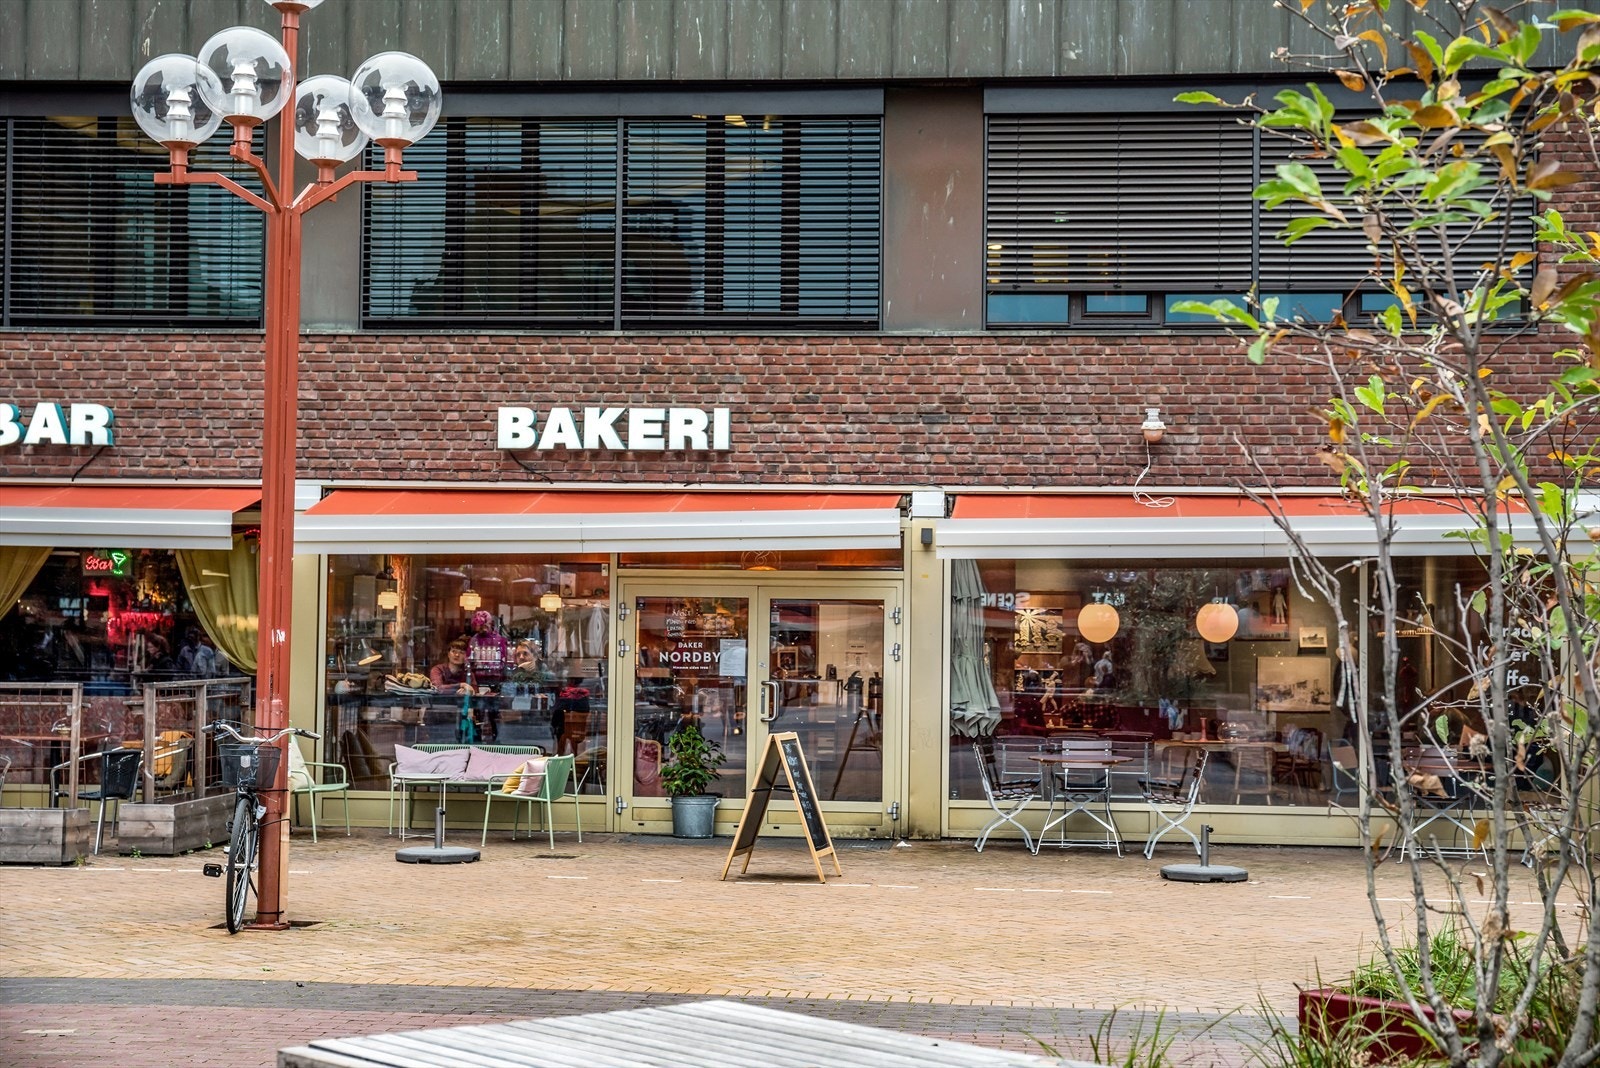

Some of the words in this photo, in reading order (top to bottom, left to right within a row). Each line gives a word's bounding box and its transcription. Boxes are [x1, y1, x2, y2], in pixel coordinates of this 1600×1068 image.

[0, 402, 113, 446] BAR
[497, 406, 731, 450] BAKERI
[85, 556, 113, 570] Bar
[659, 651, 721, 663] NORDBY
[1477, 645, 1530, 662] Ker
